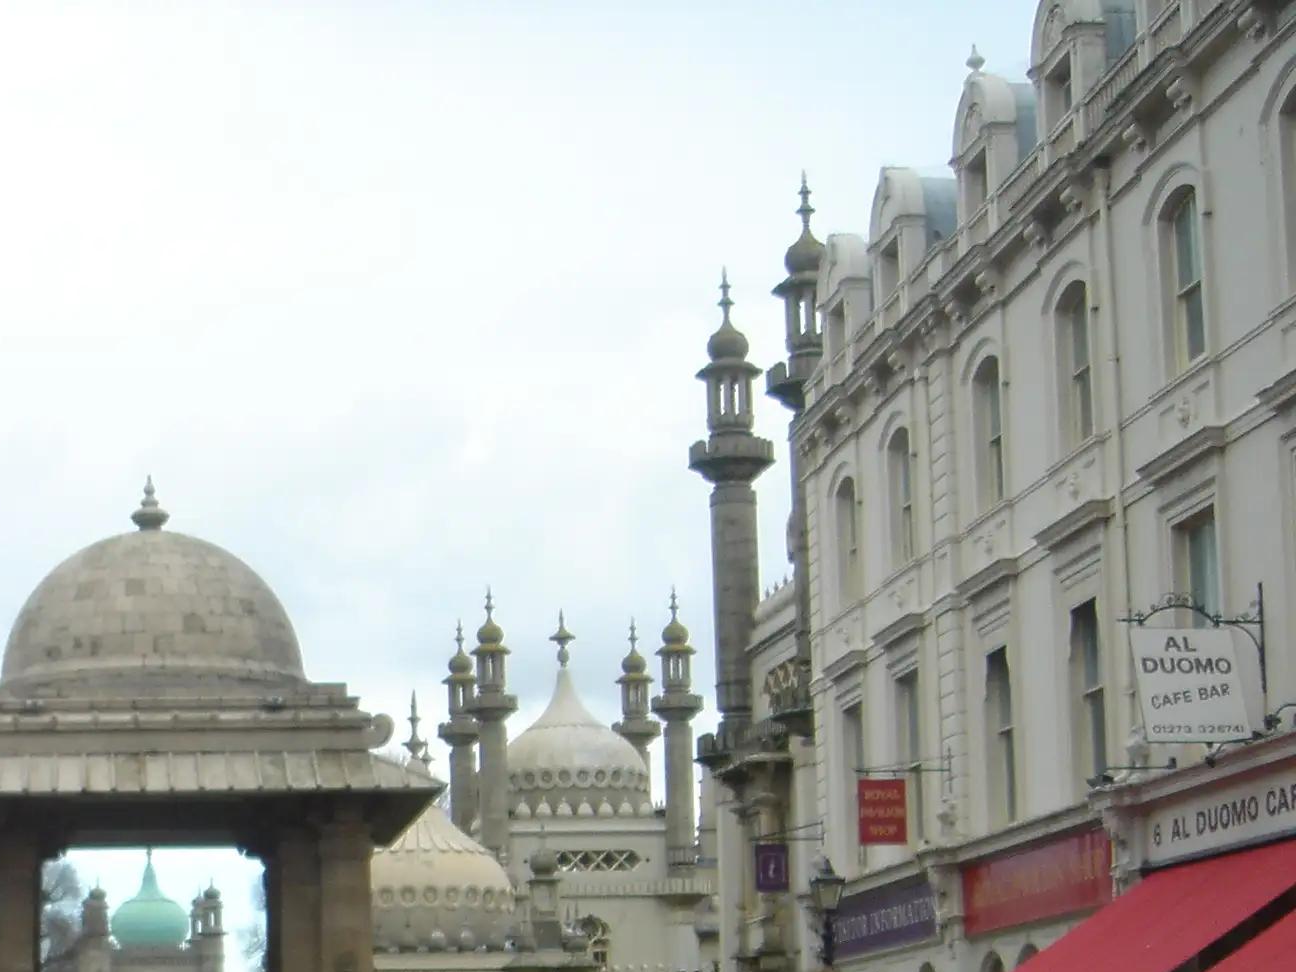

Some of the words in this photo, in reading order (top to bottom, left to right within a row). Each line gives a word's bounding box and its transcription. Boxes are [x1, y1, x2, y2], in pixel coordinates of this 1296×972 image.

[1164, 636, 1197, 652] AL
[1142, 657, 1232, 675] DUOMO
[1151, 689, 1193, 710] CAFE
[1198, 683, 1230, 701] BAR
[1171, 816, 1190, 843] AL
[1196, 796, 1259, 836] DUOMO
